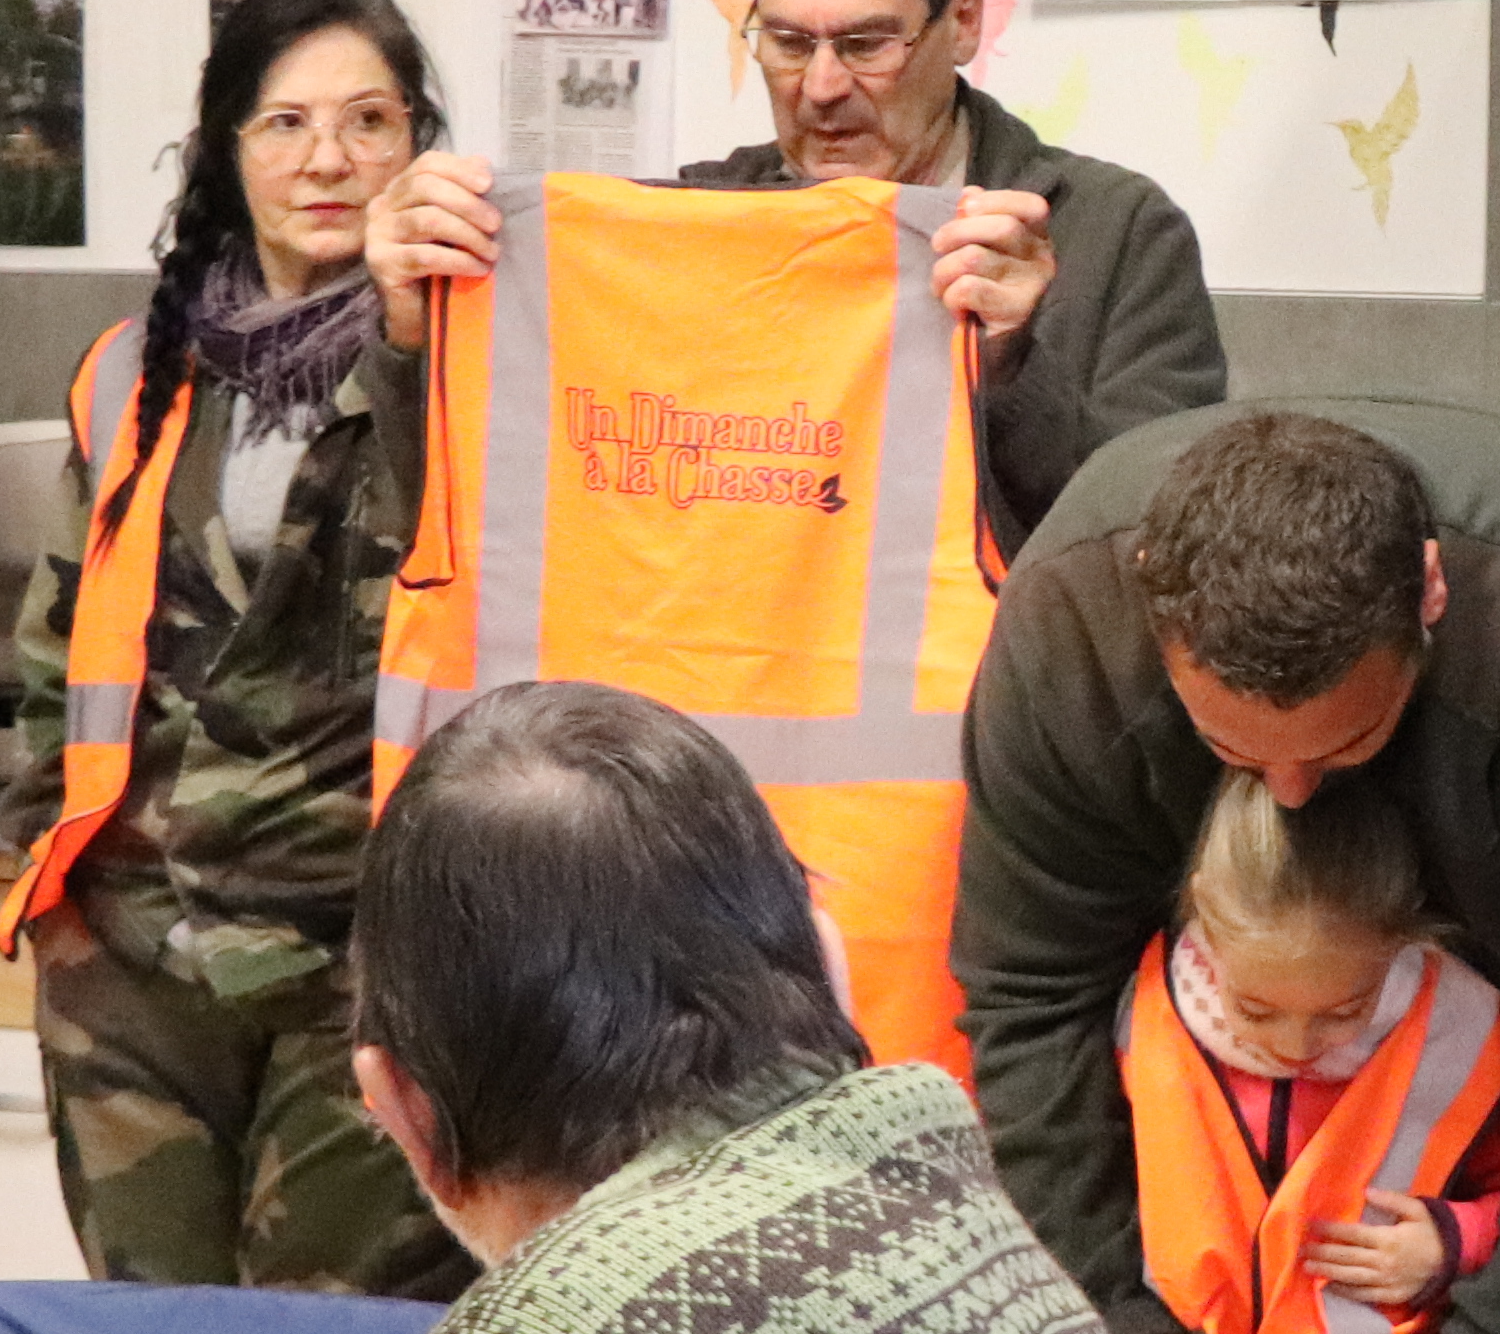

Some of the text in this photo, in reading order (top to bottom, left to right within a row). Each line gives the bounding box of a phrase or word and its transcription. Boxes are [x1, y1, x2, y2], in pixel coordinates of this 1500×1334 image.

[565, 387, 843, 457] Un Dimanche
[584, 441, 828, 509] à la Chasse
